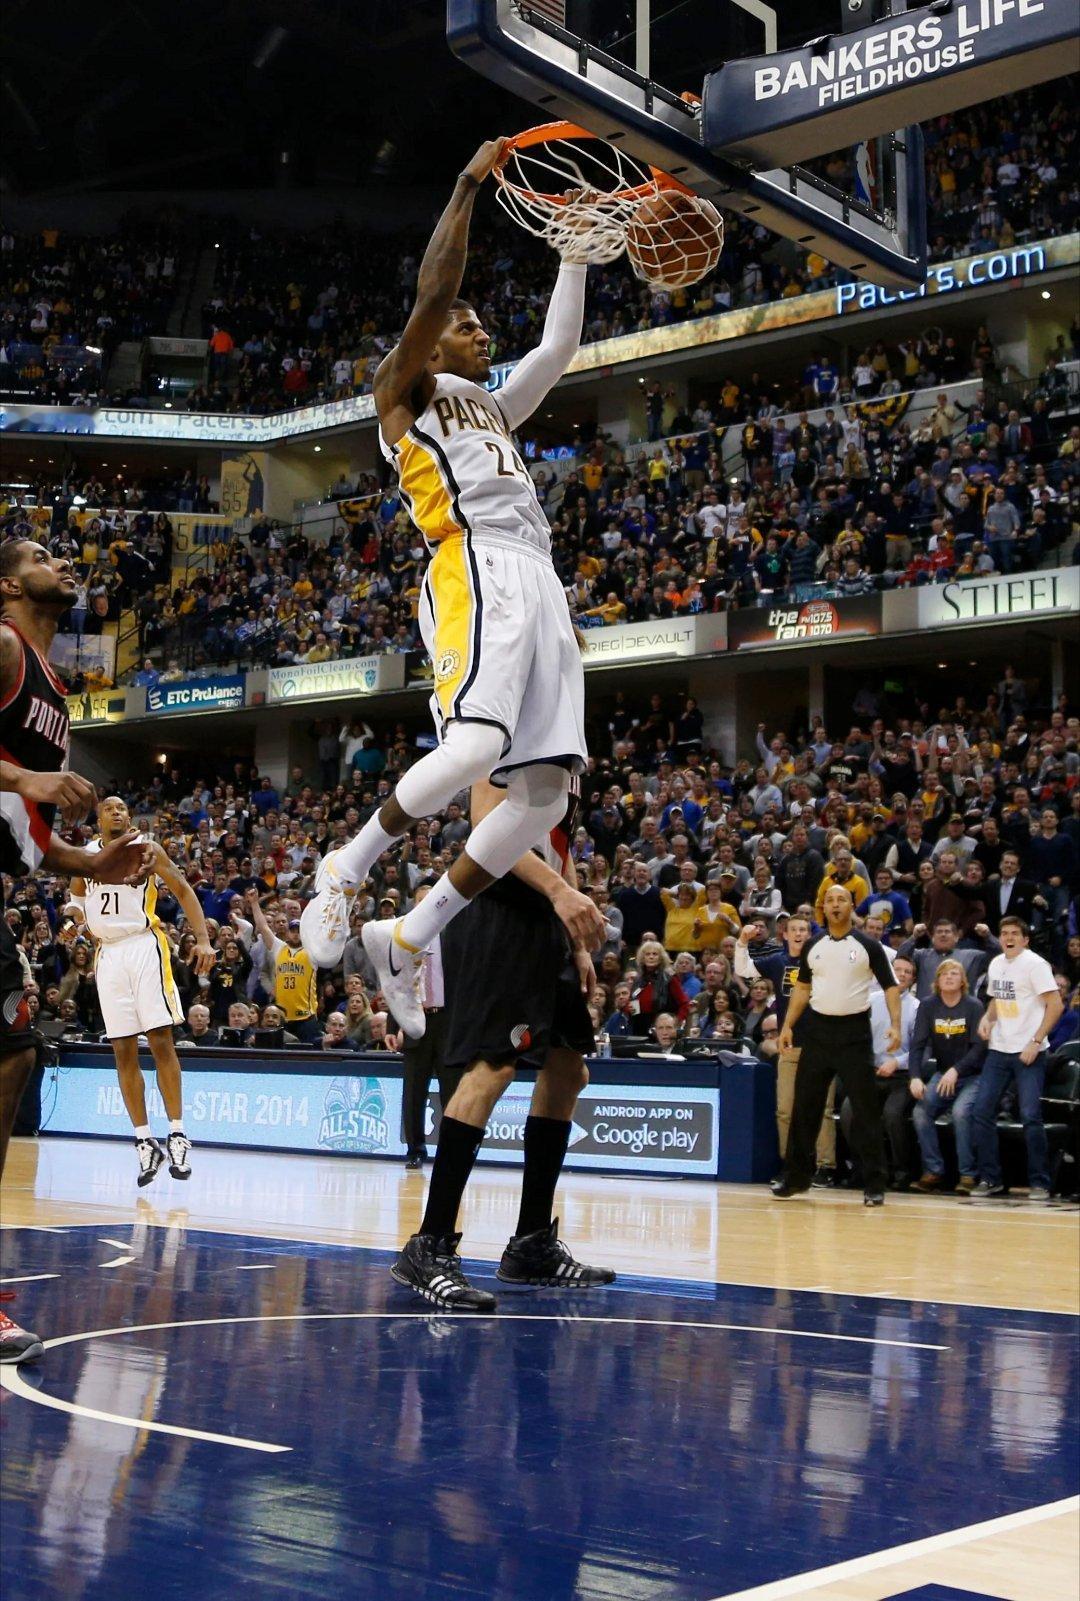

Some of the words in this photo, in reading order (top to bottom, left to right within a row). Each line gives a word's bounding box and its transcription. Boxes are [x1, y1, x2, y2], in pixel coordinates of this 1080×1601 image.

[755, 16, 944, 101] BANKERS
[957, 0, 1044, 38] LIFE
[818, 39, 975, 107] FIELDHOUSE
[768, 610, 799, 626] the
[588, 640, 620, 653] RIEG
[625, 630, 694, 649] DEVAULT
[776, 624, 807, 640] fan
[271, 658, 378, 680] MonoFoilClean.com
[166, 689, 191, 705] ETC
[191, 686, 243, 702] ProLiance
[24, 697, 69, 751] PORTLA
[101, 892, 119, 915] 21
[283, 976, 296, 990] 33
[97, 1086, 129, 1116] NB
[255, 1095, 309, 1128] 2014
[594, 1106, 647, 1119] ANDROID
[649, 1108, 673, 1120] APP
[675, 1109, 693, 1120] ON
[593, 1122, 658, 1153] Google
[661, 1126, 699, 1153] play
